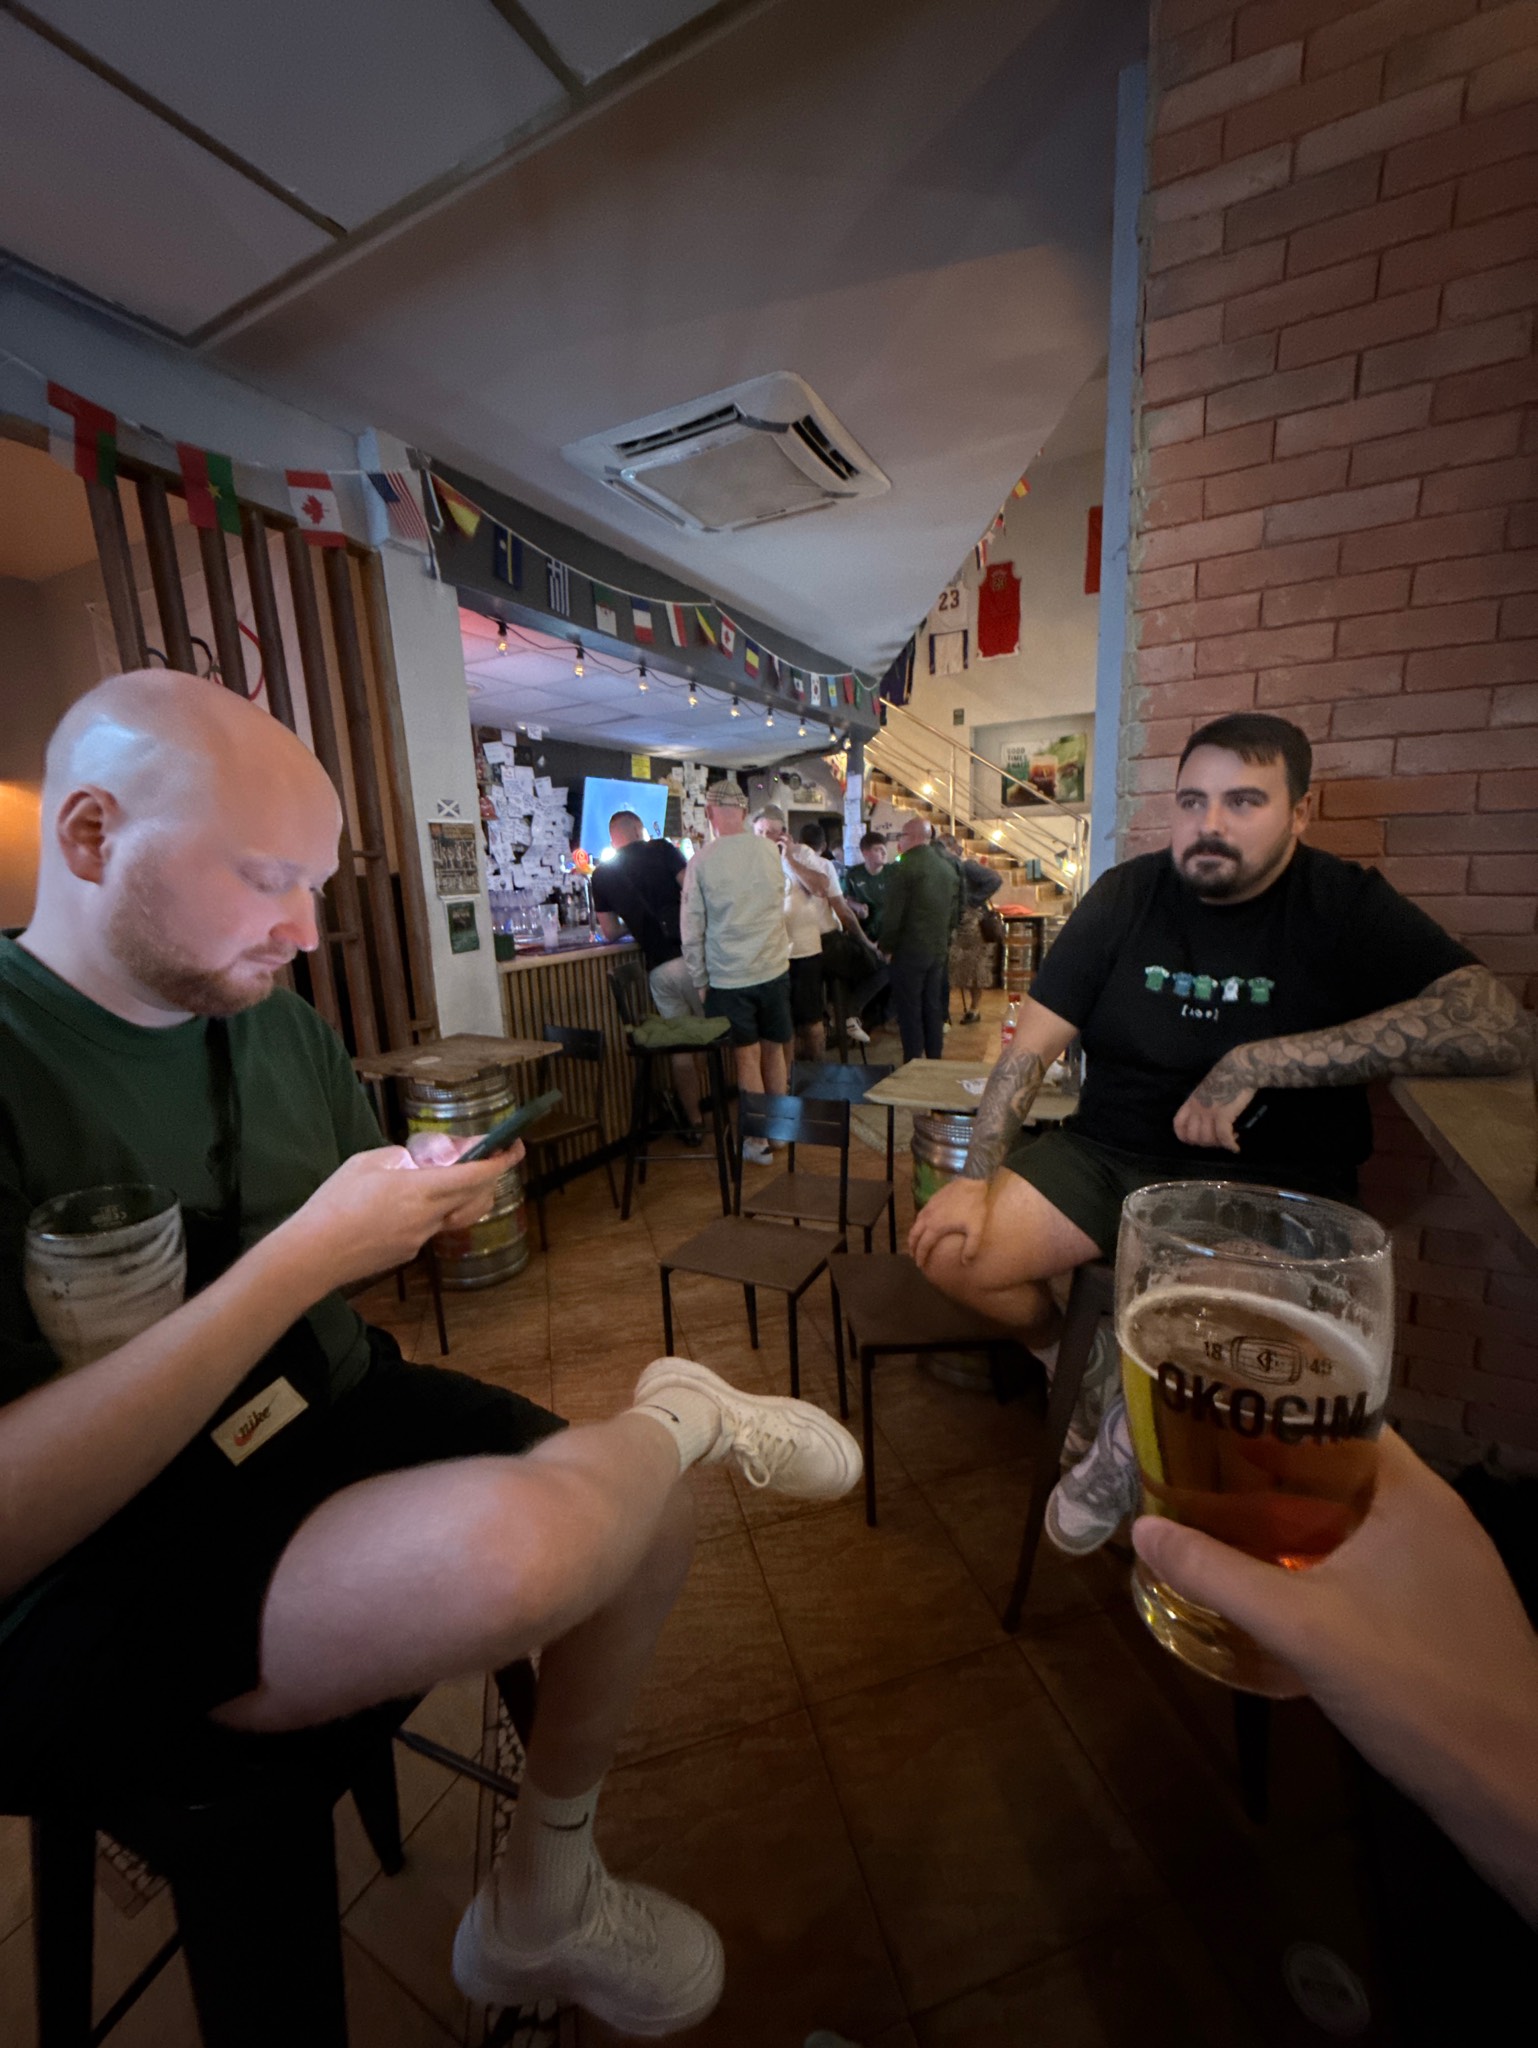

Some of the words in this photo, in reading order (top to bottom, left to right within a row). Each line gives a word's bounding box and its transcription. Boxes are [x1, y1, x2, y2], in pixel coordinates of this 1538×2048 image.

[938, 589, 960, 612] 23
[1203, 1341, 1221, 1361] 18
[1158, 1362, 1368, 1444] OKOCIM
[239, 1405, 272, 1438] nike
